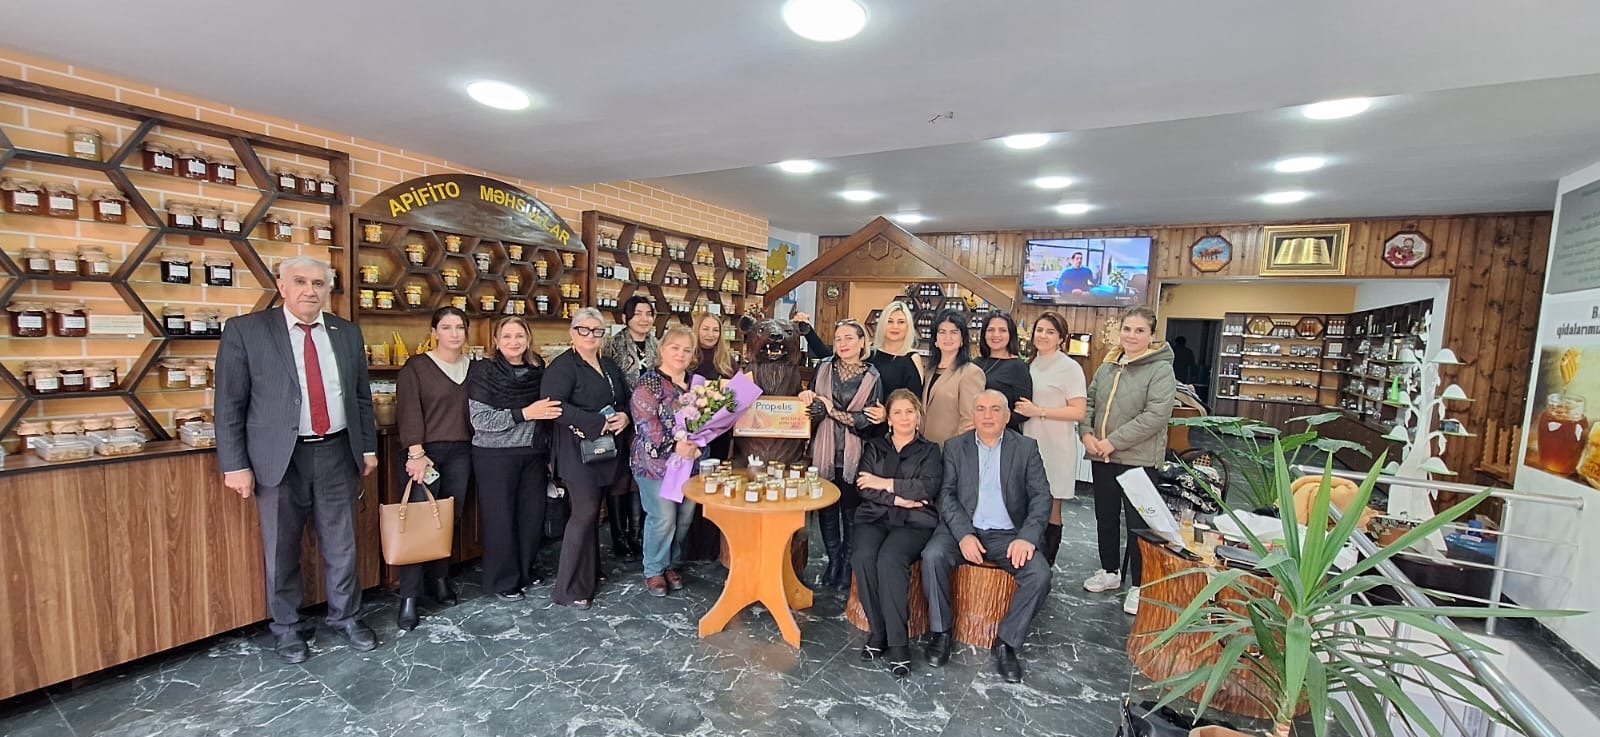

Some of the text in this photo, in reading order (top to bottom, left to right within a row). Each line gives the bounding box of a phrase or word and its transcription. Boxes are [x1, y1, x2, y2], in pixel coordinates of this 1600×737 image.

[389, 181, 460, 217] APİFİTO
[1592, 305, 1600, 319] B
[755, 402, 792, 412] Propolis
